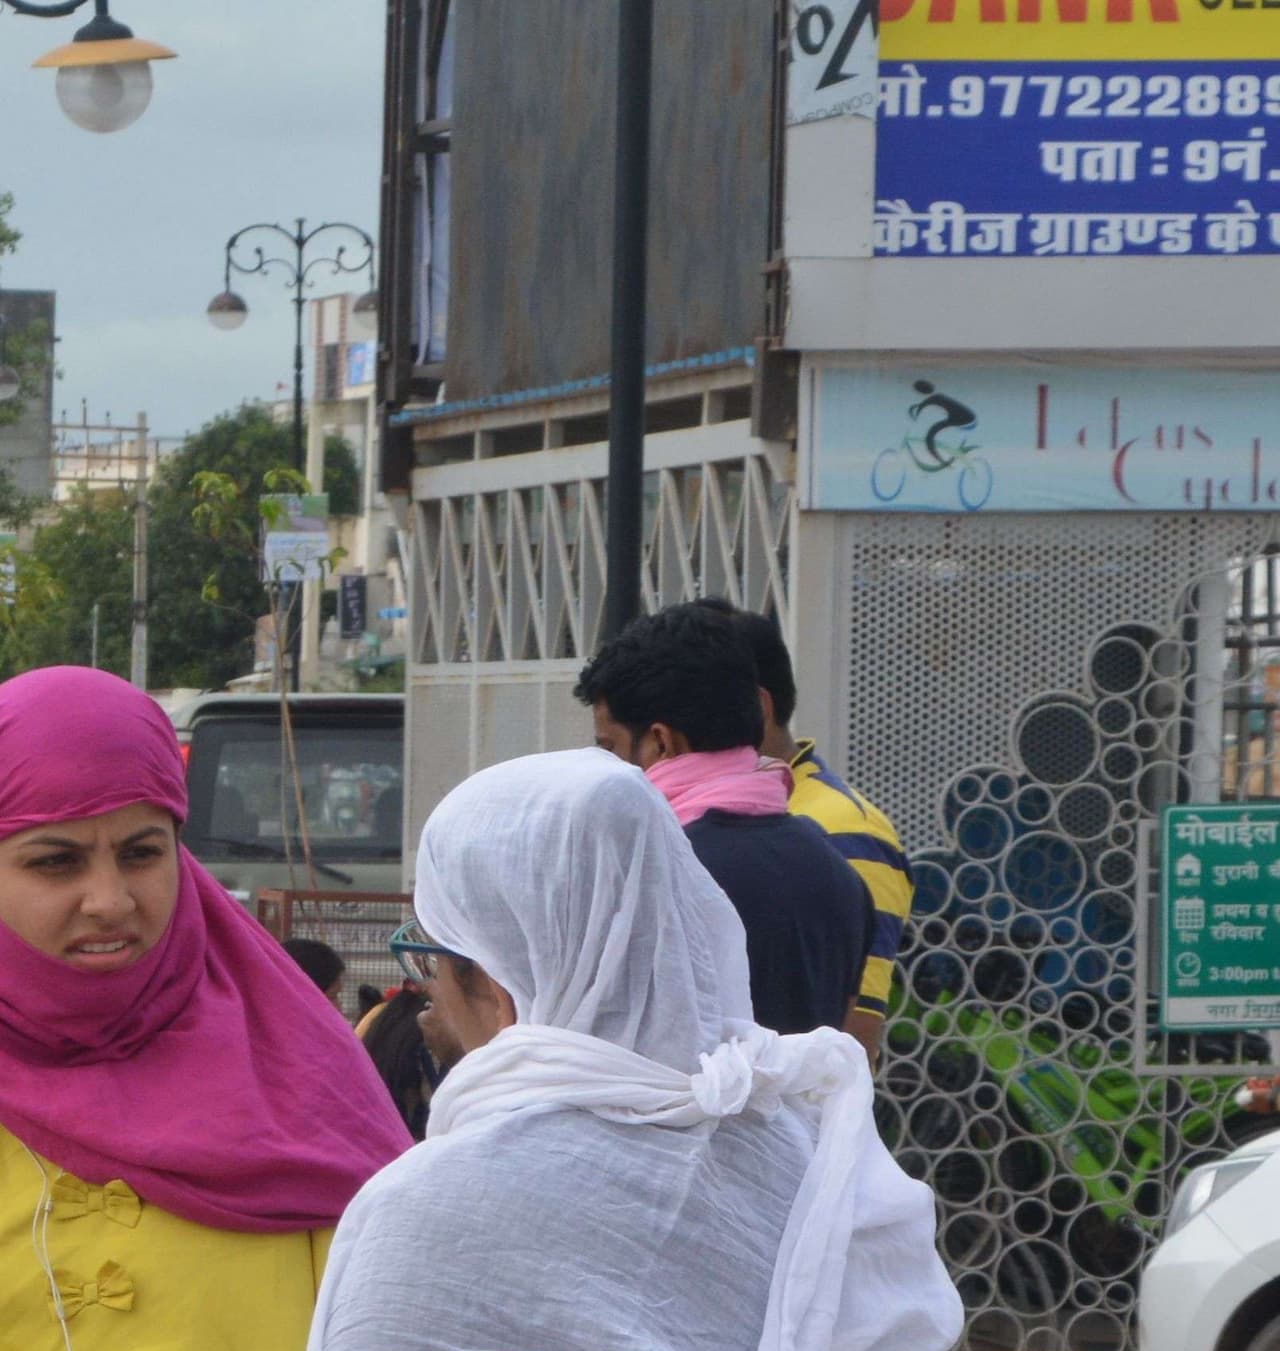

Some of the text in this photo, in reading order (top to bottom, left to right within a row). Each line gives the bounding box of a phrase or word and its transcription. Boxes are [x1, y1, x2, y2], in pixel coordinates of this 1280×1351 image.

[1040, 141, 1142, 181] पता
[1203, 199, 1261, 252] के
[1175, 813, 1279, 849] मोबाईल
[1208, 966, 1269, 984] 3:00pm
